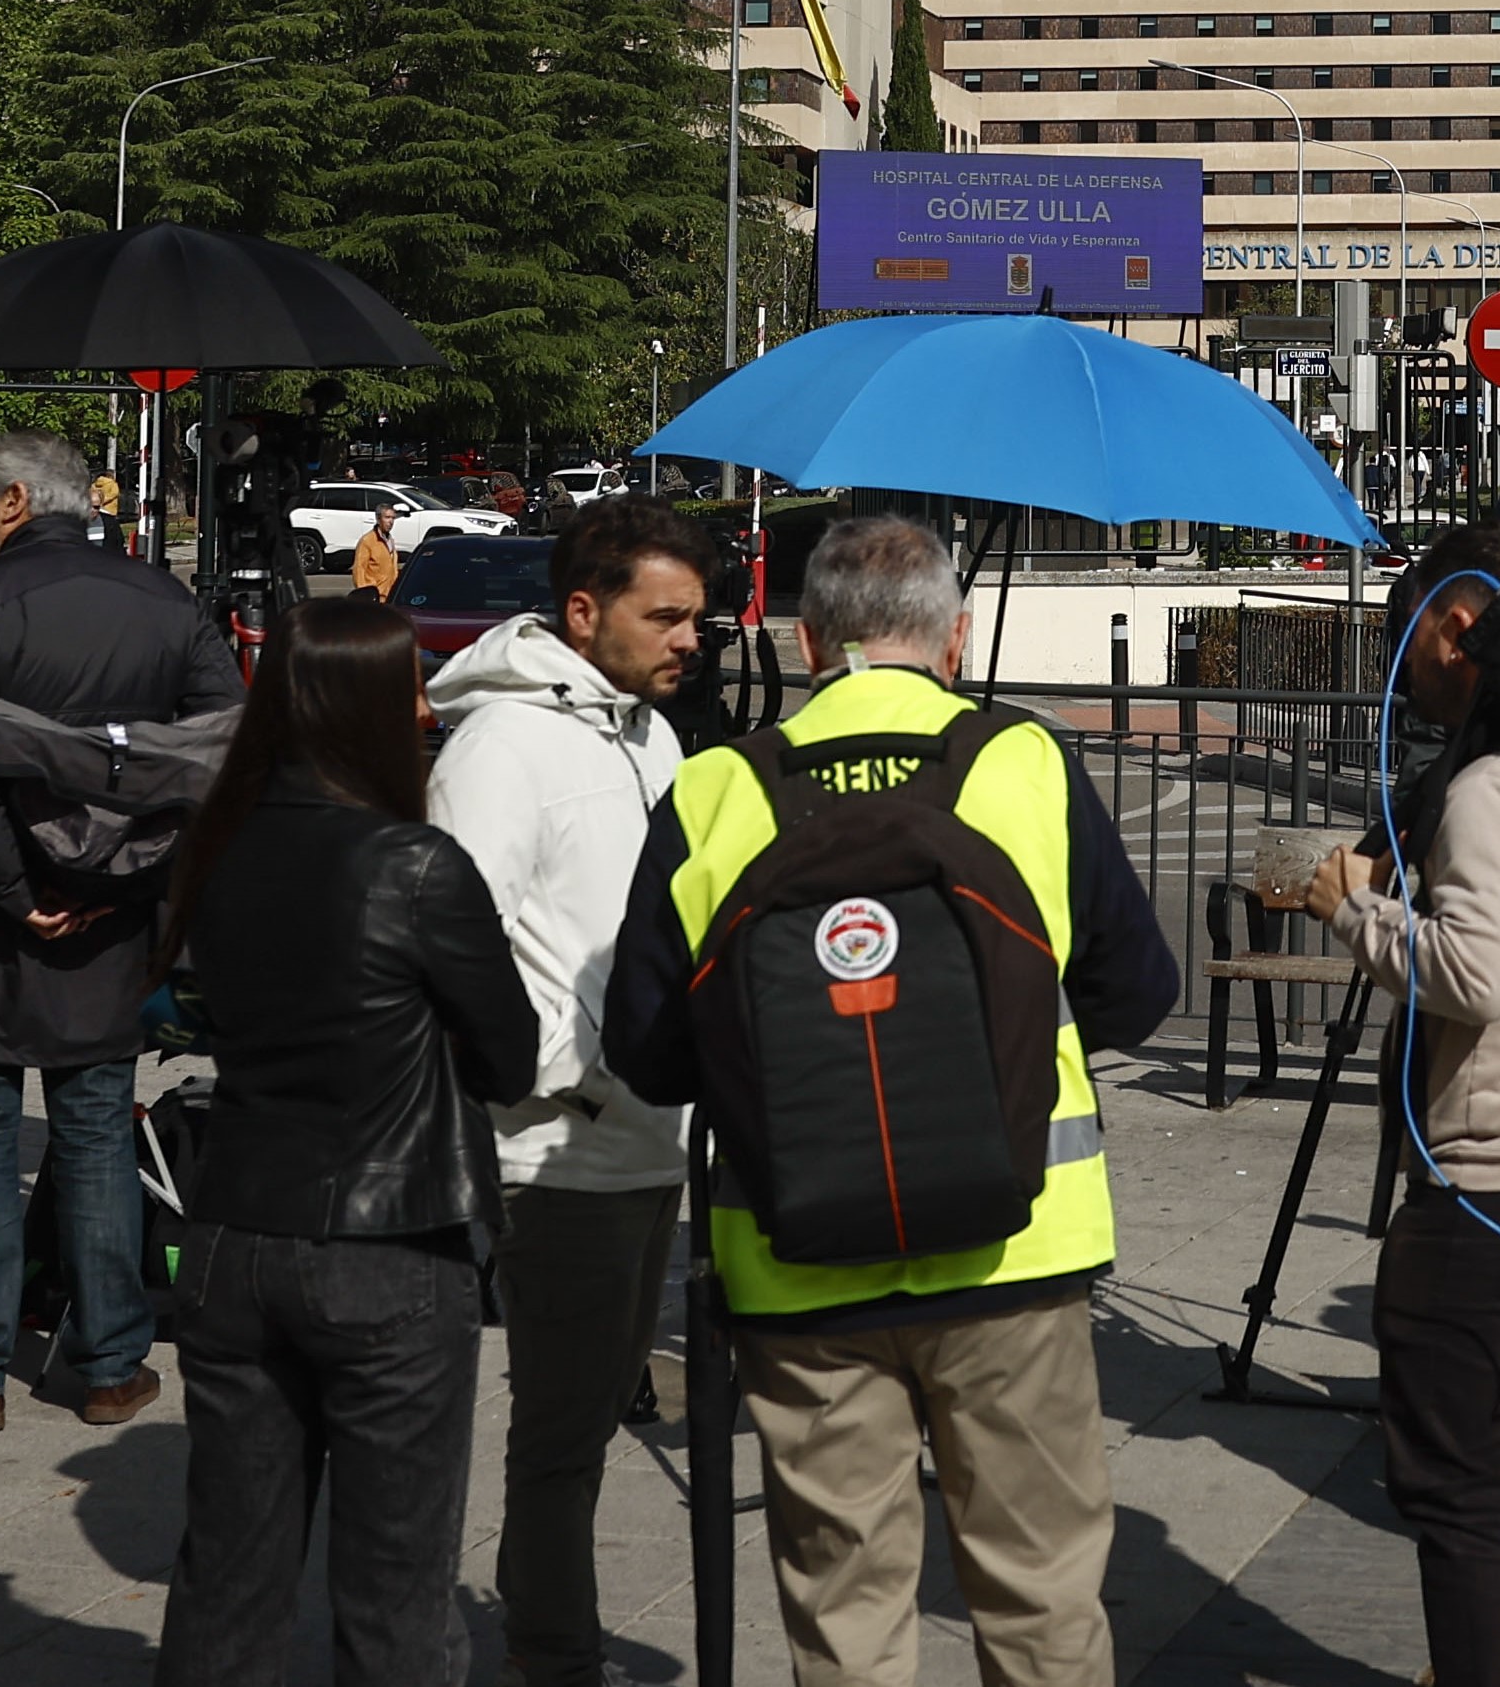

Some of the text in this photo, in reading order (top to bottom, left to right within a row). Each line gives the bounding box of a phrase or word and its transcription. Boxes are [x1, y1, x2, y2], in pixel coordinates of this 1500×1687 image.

[873, 170, 1163, 190] HOSPITAL CENTRAL DE LA DEFENSA
[927, 192, 1111, 224] GÓMEZ ULLA
[898, 230, 1140, 250] Centro Sanitario de Vida y Esperanza
[1202, 243, 1338, 270] ENTRAL
[1347, 244, 1392, 270] DE
[1401, 244, 1445, 270] LA
[1290, 350, 1326, 359] GLORIETA
[1282, 364, 1325, 375] EJERCITO
